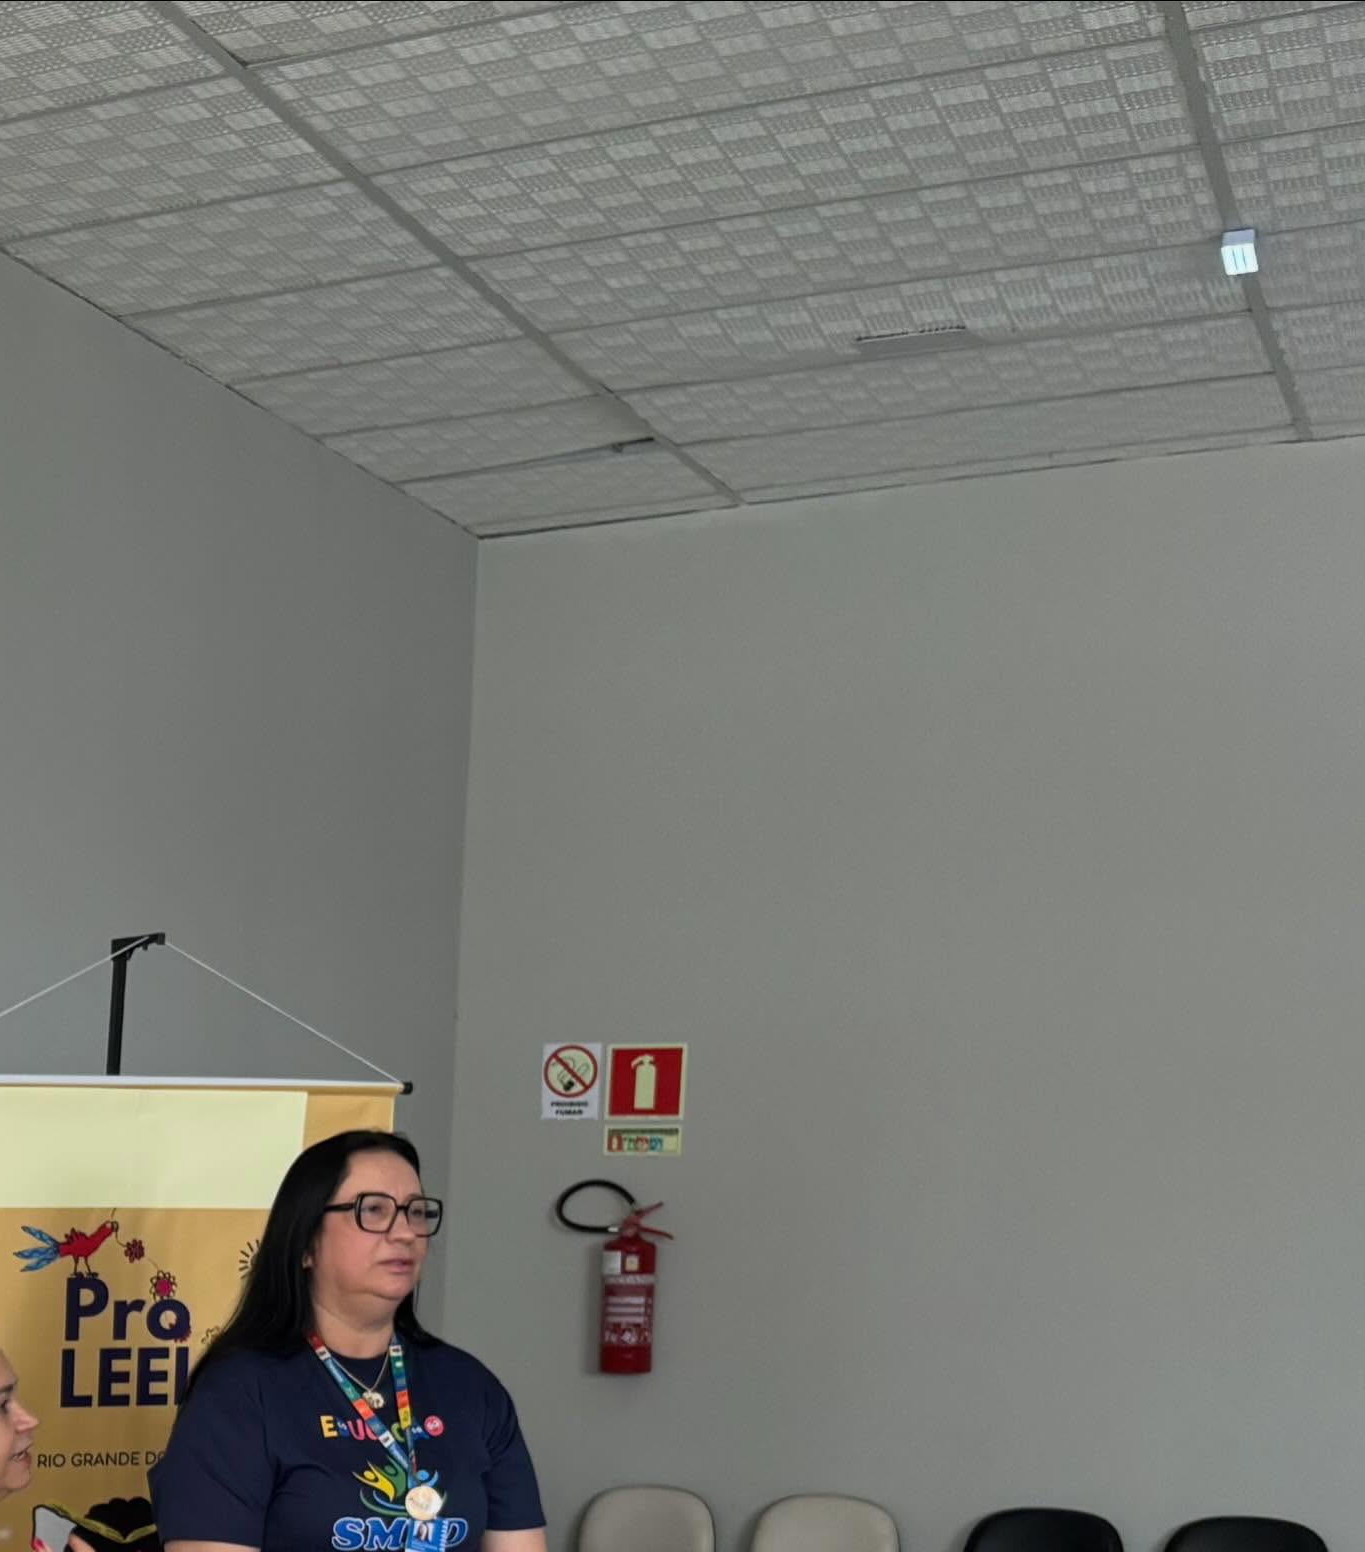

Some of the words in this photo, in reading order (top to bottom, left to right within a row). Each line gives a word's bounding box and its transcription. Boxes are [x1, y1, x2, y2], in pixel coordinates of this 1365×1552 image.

[36, 1452, 66, 1468] RIO
[70, 1451, 140, 1467] GRANDE
[331, 1516, 469, 1551] SMD
